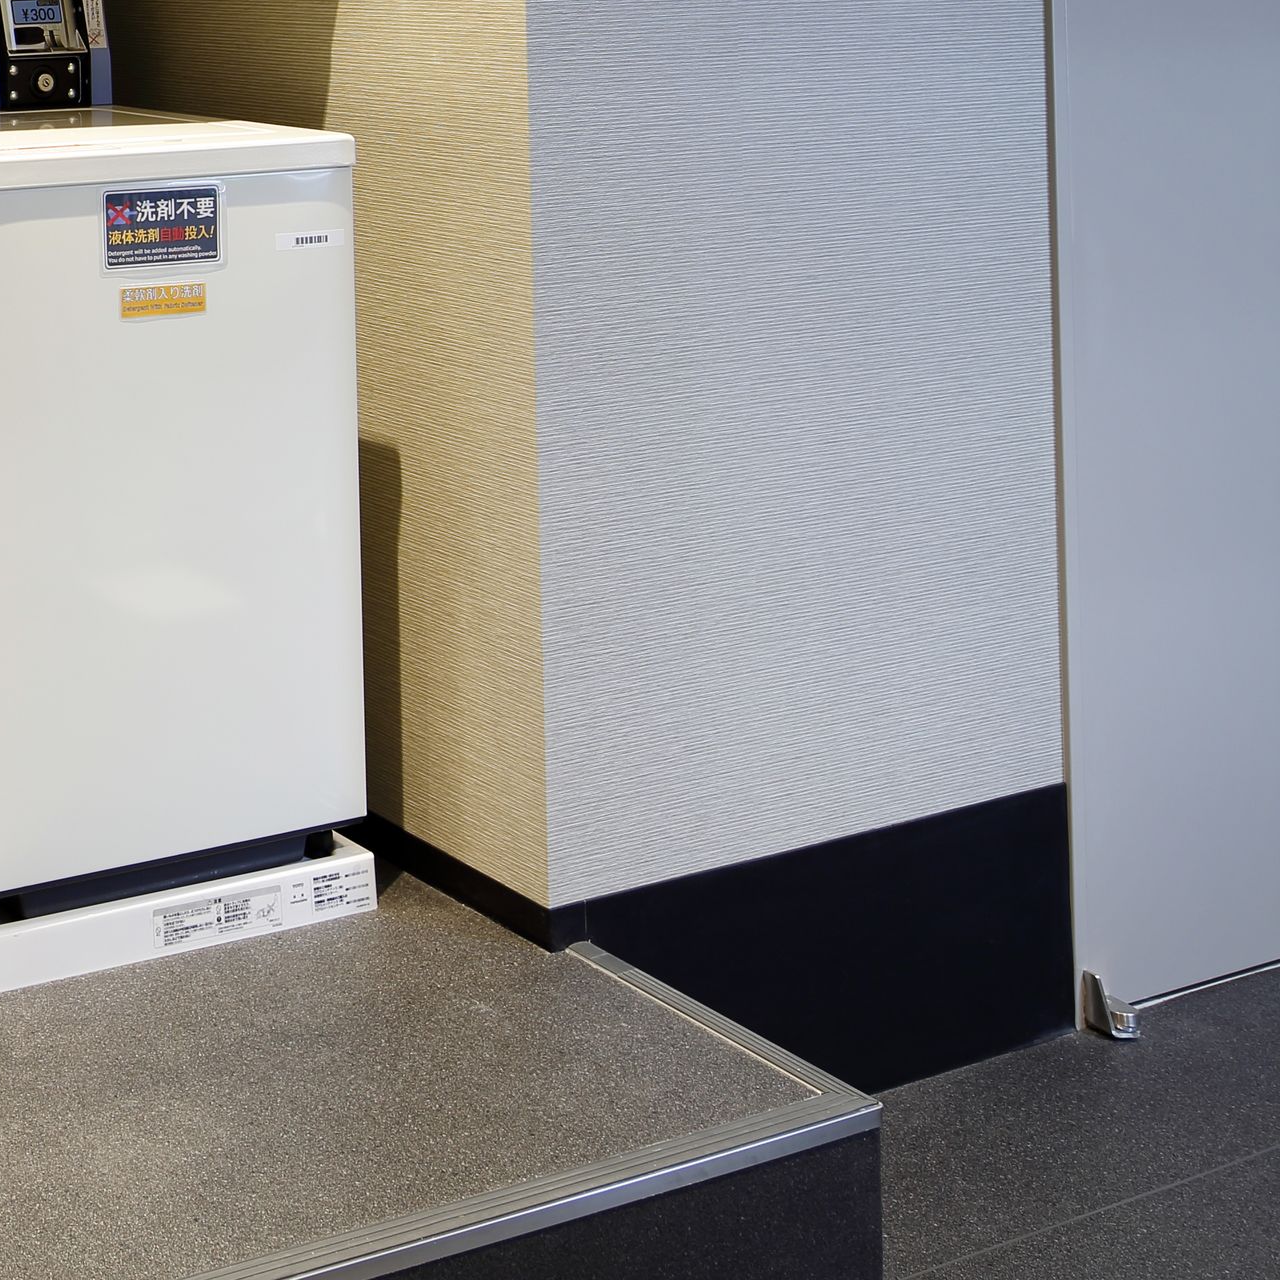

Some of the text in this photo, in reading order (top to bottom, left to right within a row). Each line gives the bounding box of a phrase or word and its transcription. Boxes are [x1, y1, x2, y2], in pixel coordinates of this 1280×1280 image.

[22, 8, 55, 22] ¥300
[136, 196, 215, 223] 洗剤不要
[108, 224, 215, 246] 液体洗剤自動投入!
[123, 284, 203, 302] 柔軟剤入り洗剤
